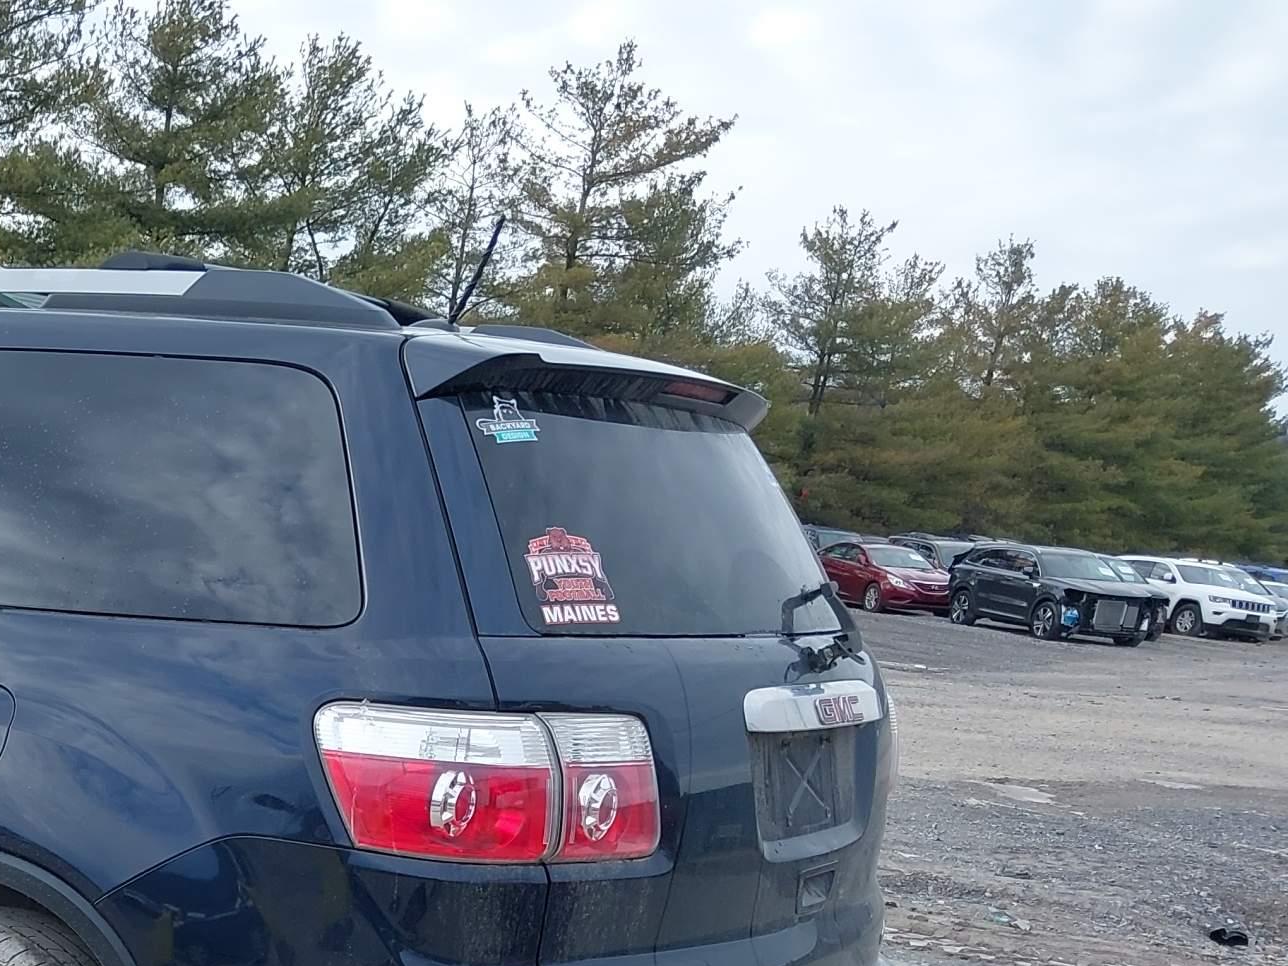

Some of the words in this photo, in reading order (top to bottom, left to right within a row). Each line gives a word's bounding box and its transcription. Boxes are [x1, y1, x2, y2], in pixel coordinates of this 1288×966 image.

[527, 554, 603, 583] PUNXSY
[541, 604, 620, 623] MAINES
[815, 695, 865, 725] GMC
